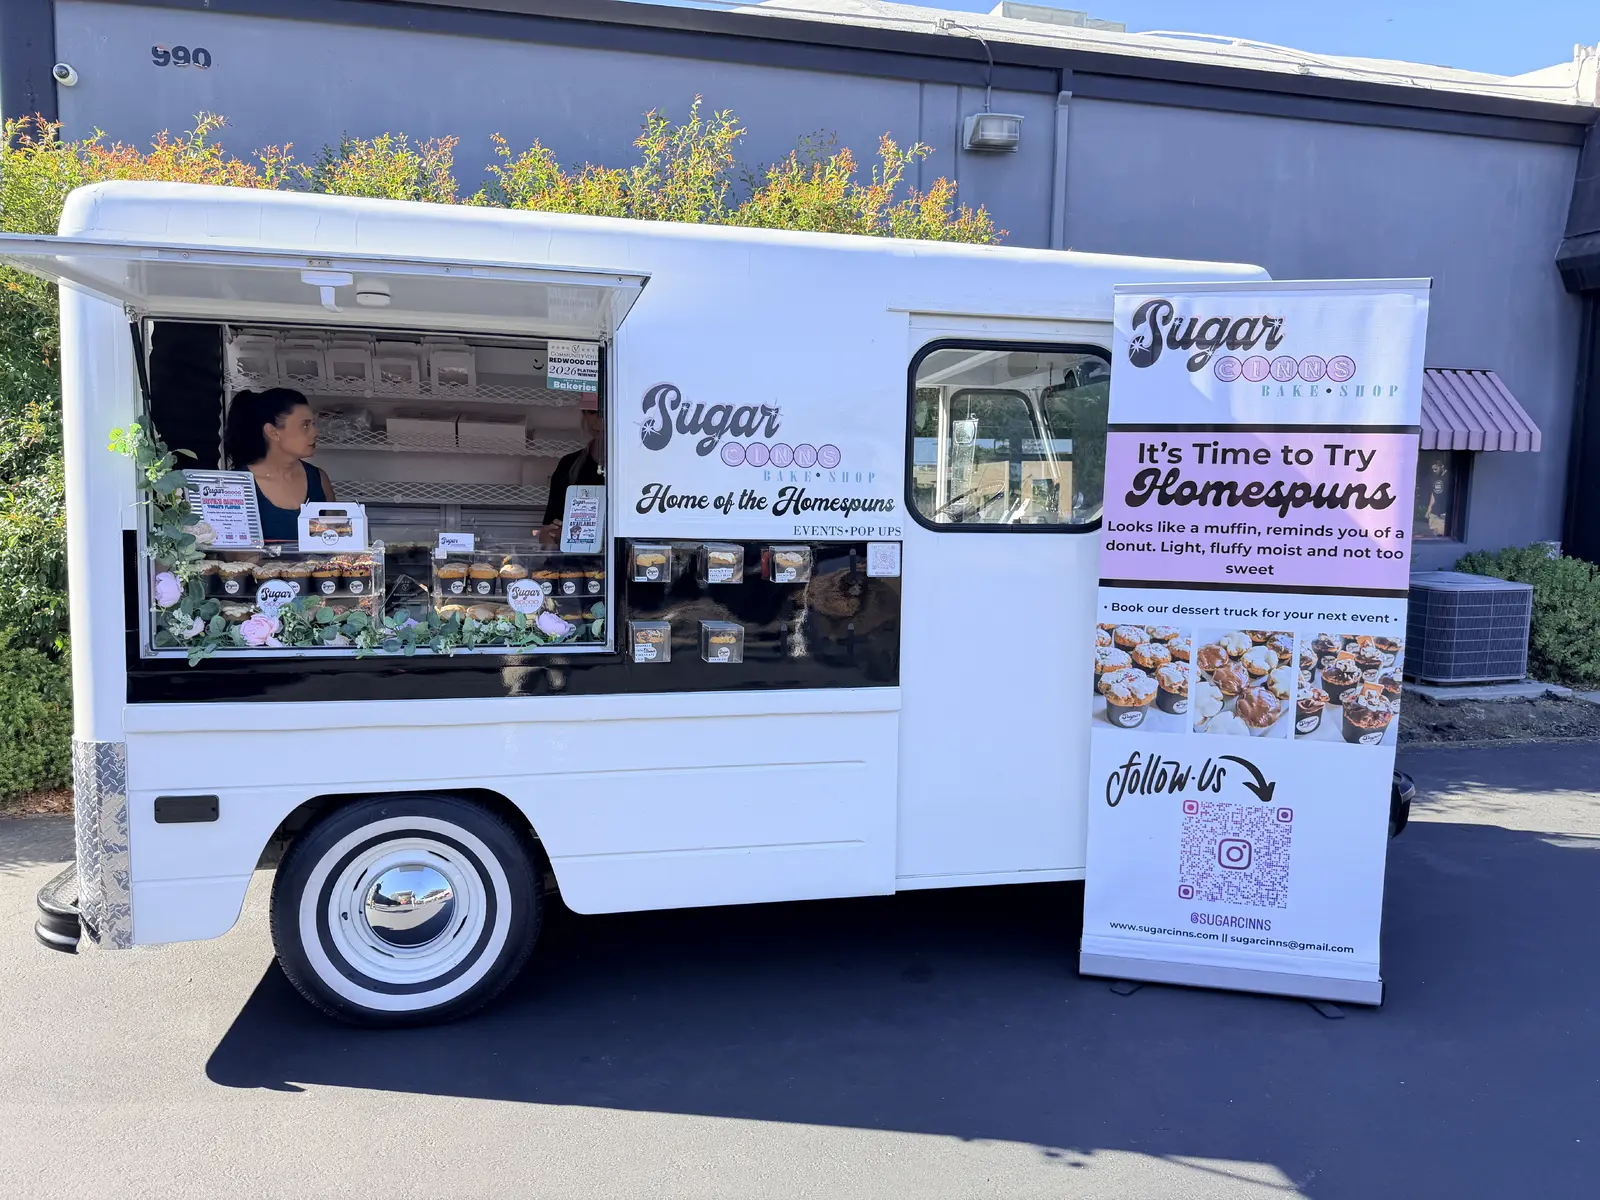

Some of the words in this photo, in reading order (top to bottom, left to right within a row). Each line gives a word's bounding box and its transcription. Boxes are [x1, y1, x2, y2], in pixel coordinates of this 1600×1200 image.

[151, 44, 212, 70] 990
[1128, 298, 1287, 373] Sugar
[549, 357, 585, 365] REDWOOD
[549, 365, 577, 376] 2026
[1214, 355, 1356, 382] CINNS
[553, 380, 597, 391] Bakeries
[1261, 384, 1318, 397] BAKE
[1339, 384, 1399, 398] SHOP
[640, 382, 781, 457] Sugar
[721, 441, 841, 469] CINNS
[1192, 440, 1271, 465] Time
[1281, 444, 1313, 466] to
[1323, 444, 1376, 472] Try
[763, 470, 812, 482] BAKE
[829, 470, 876, 484] SHOP
[636, 482, 710, 515] Home
[713, 491, 735, 515] of
[737, 488, 768, 511] the
[772, 485, 895, 518] Homespuns
[1125, 467, 1397, 519] Homespuns
[793, 525, 844, 536] EVENTS
[850, 526, 875, 537] POP
[878, 526, 901, 537] UPS
[1107, 521, 1153, 532] Looks
[1157, 521, 1186, 533] like
[1190, 524, 1199, 533] a
[1204, 523, 1261, 537] muffin,
[1266, 524, 1333, 537] reminds
[1337, 528, 1368, 540] you
[1374, 527, 1392, 538] of
[1395, 529, 1405, 539] a
[1105, 540, 1156, 552] donut.
[1160, 541, 1205, 555] Light,
[1210, 542, 1252, 557] fluffy
[1256, 543, 1302, 556] moist
[1307, 546, 1338, 557] and
[1343, 547, 1371, 558] not
[1376, 548, 1404, 559] too
[1225, 564, 1274, 575] sweet
[260, 587, 292, 601] Sugar
[511, 586, 540, 600] Sugar
[1111, 602, 1144, 612] Book
[1147, 605, 1168, 613] our
[1172, 604, 1220, 616] dessert
[1224, 606, 1258, 617] truck
[1262, 608, 1280, 618] for
[1283, 610, 1314, 620] your
[1317, 611, 1347, 621] next
[1351, 613, 1389, 623] event
[1190, 912, 1272, 931] @SUGARCINNS
[1109, 921, 1219, 940] www.sugarcinns.com
[1230, 934, 1354, 954] sugarcinns@gmail.com
